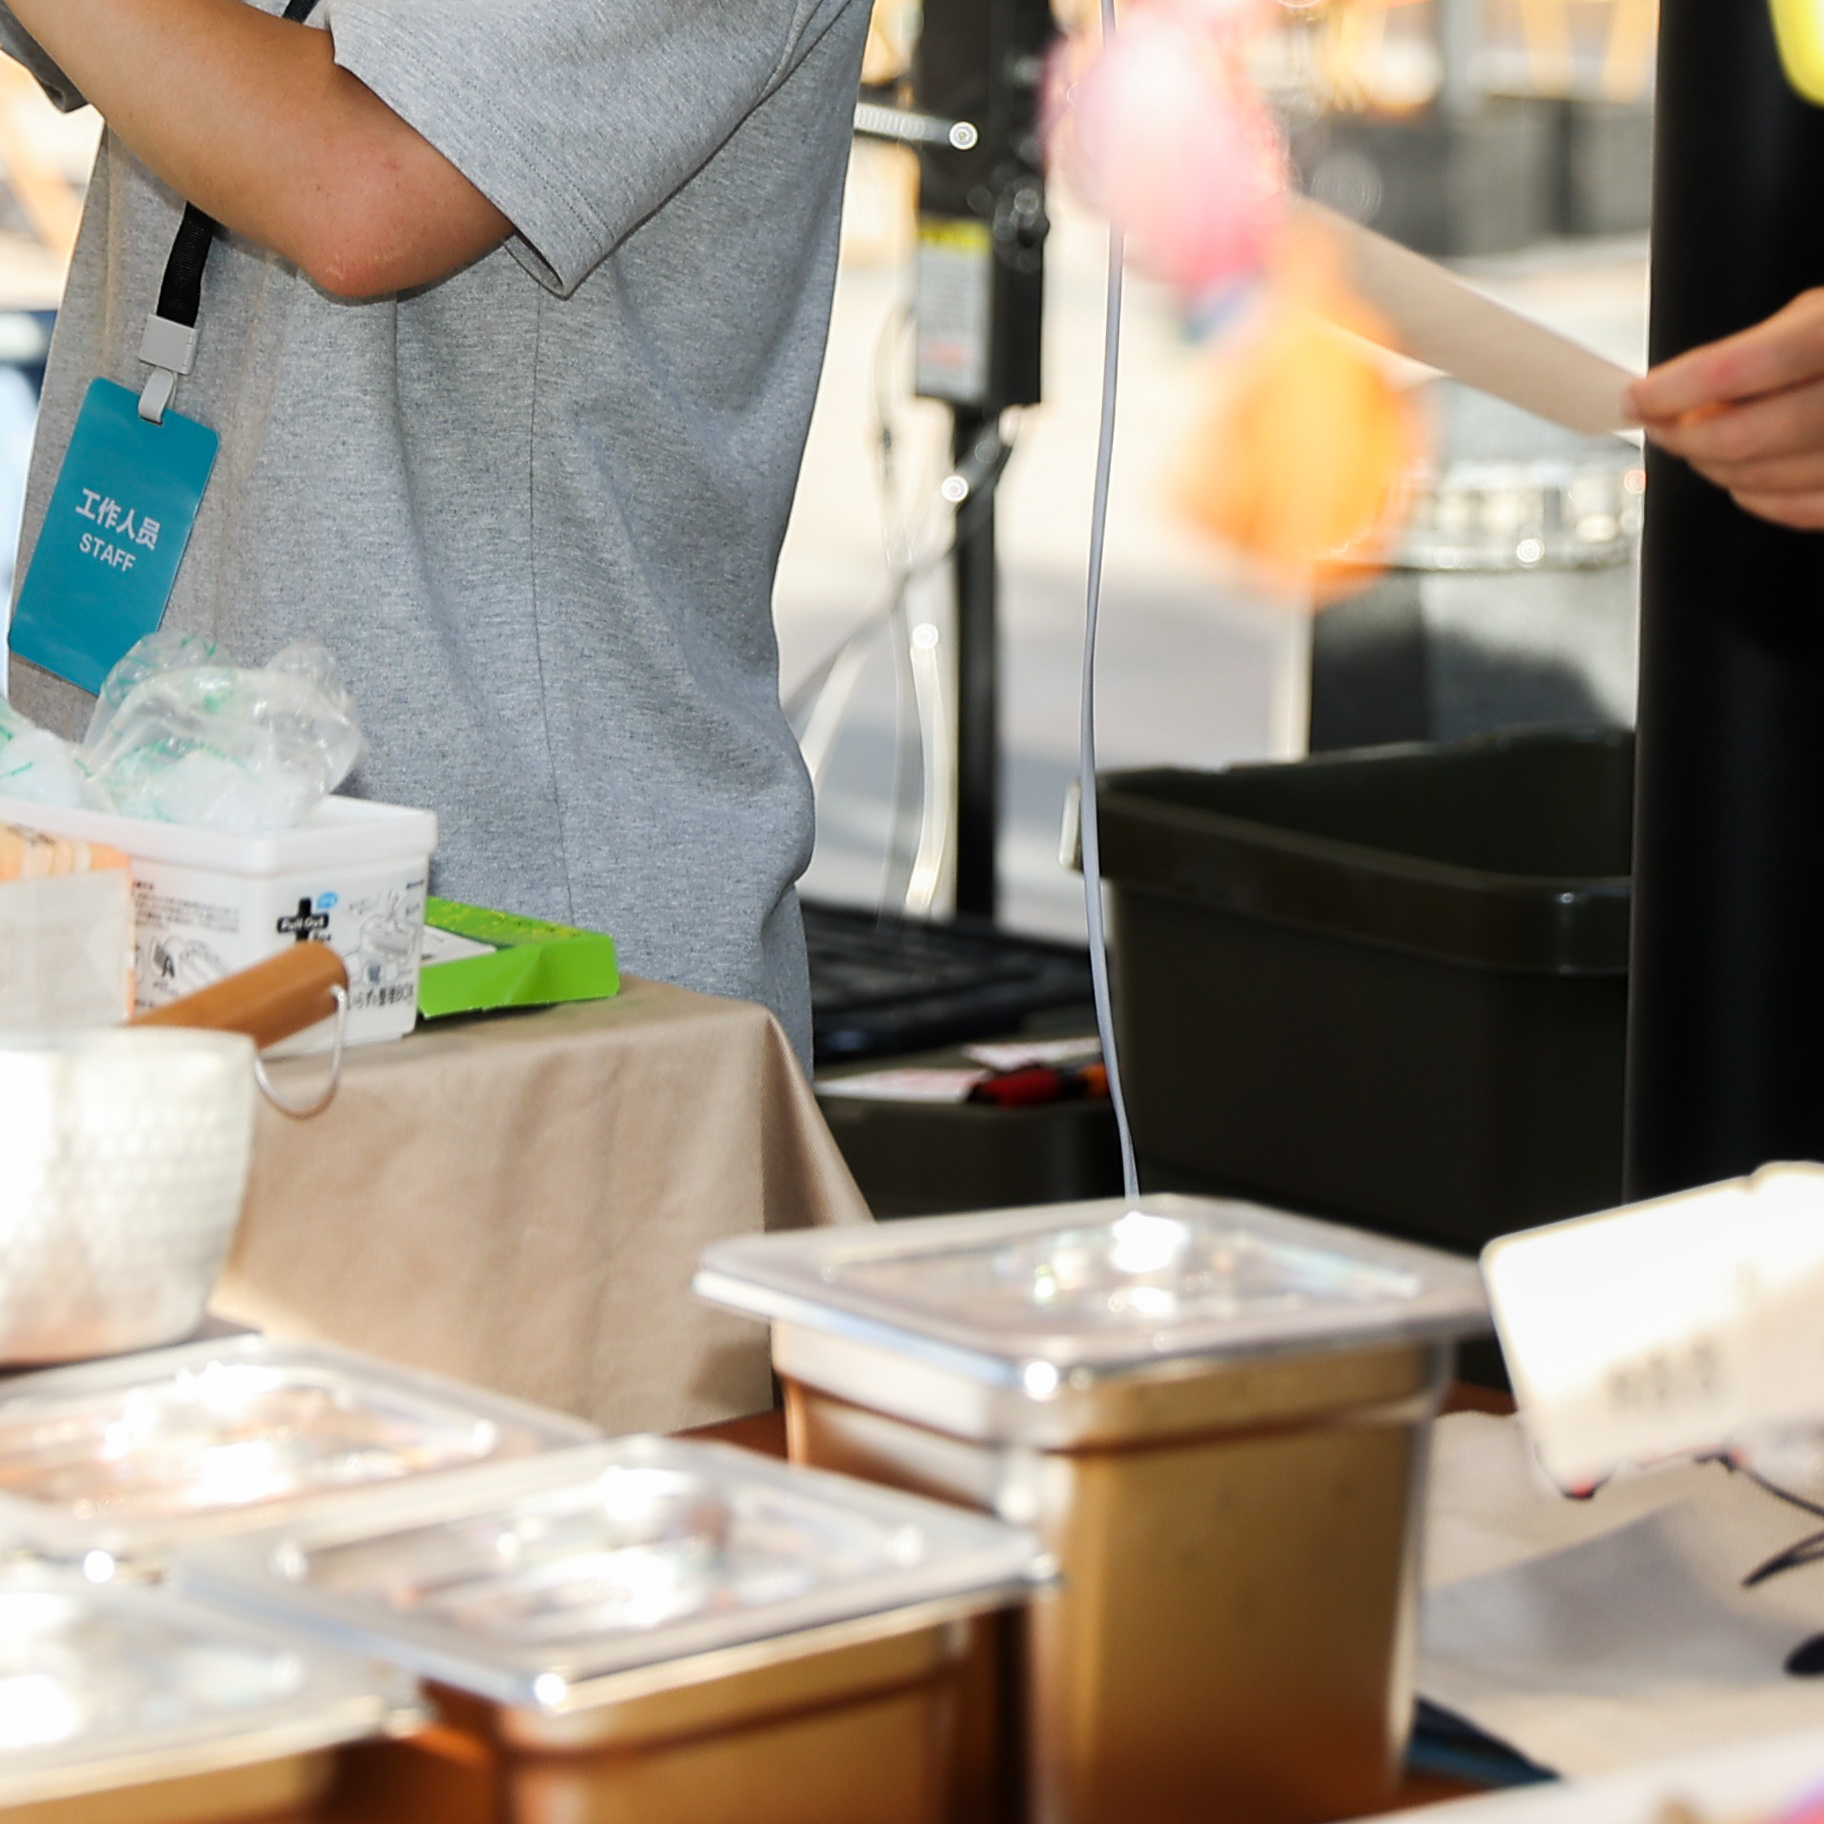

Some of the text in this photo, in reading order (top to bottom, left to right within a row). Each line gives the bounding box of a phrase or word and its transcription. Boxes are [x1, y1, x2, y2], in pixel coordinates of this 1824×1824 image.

[75, 488, 161, 551] 工作人员
[79, 533, 136, 572] STAFF
